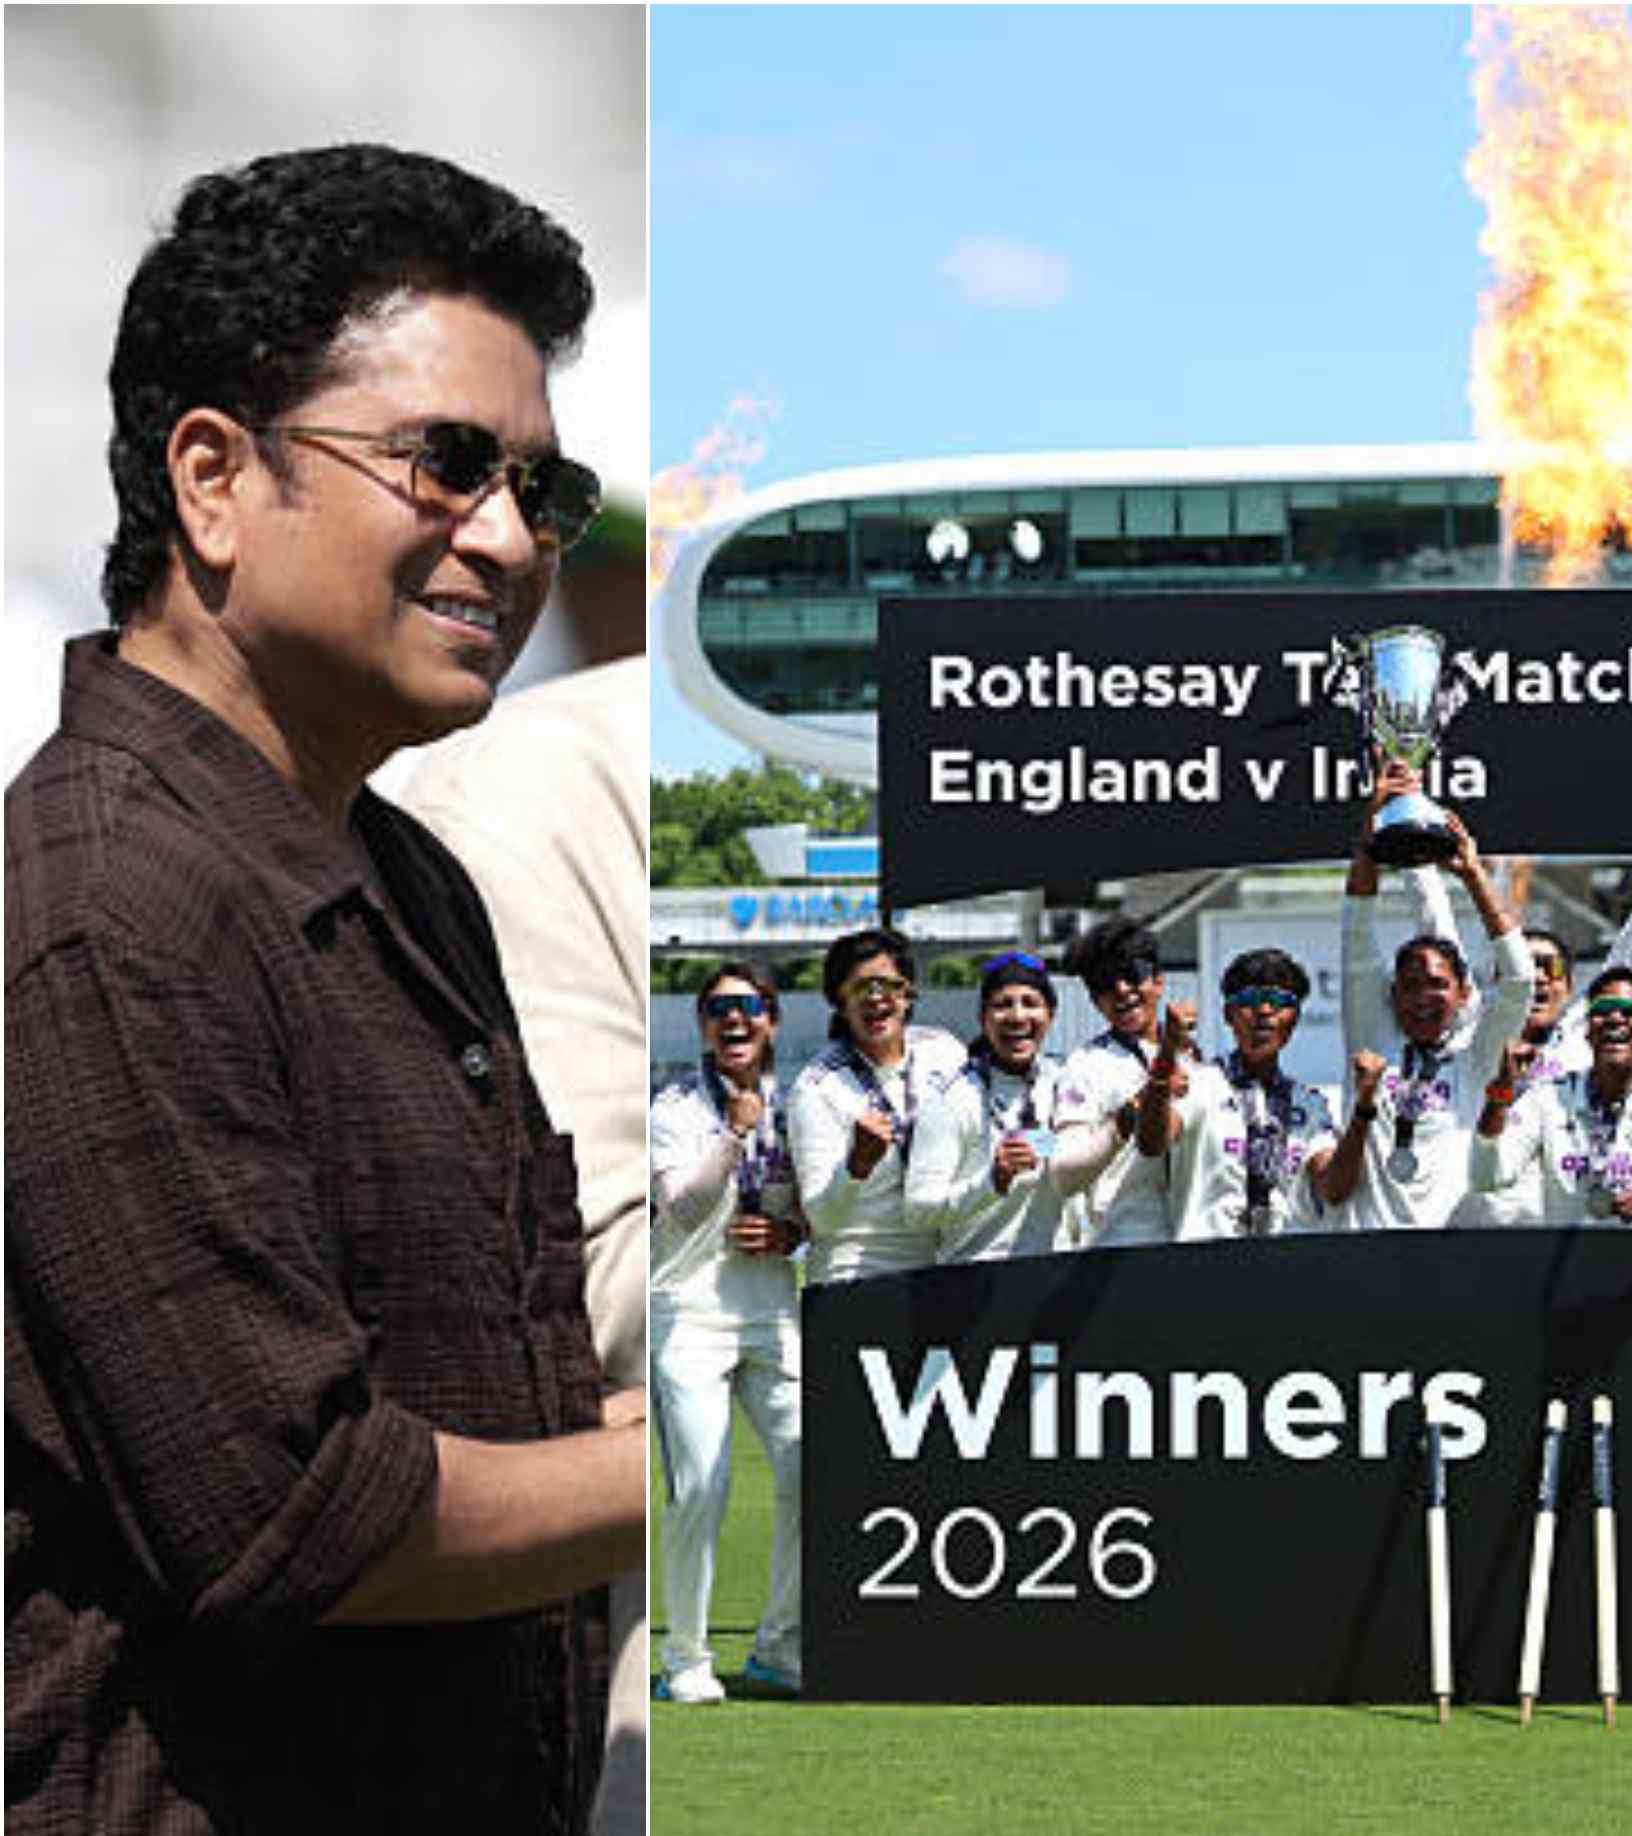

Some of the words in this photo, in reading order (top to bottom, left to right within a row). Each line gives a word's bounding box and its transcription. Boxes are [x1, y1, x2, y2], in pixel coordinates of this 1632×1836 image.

[930, 651, 1261, 717] Rothesay
[930, 746, 1220, 814] England
[1245, 759, 1286, 801] v
[1313, 746, 1487, 801] Inia
[857, 1343, 1488, 1462] Winners
[857, 1506, 1158, 1600] 2026
